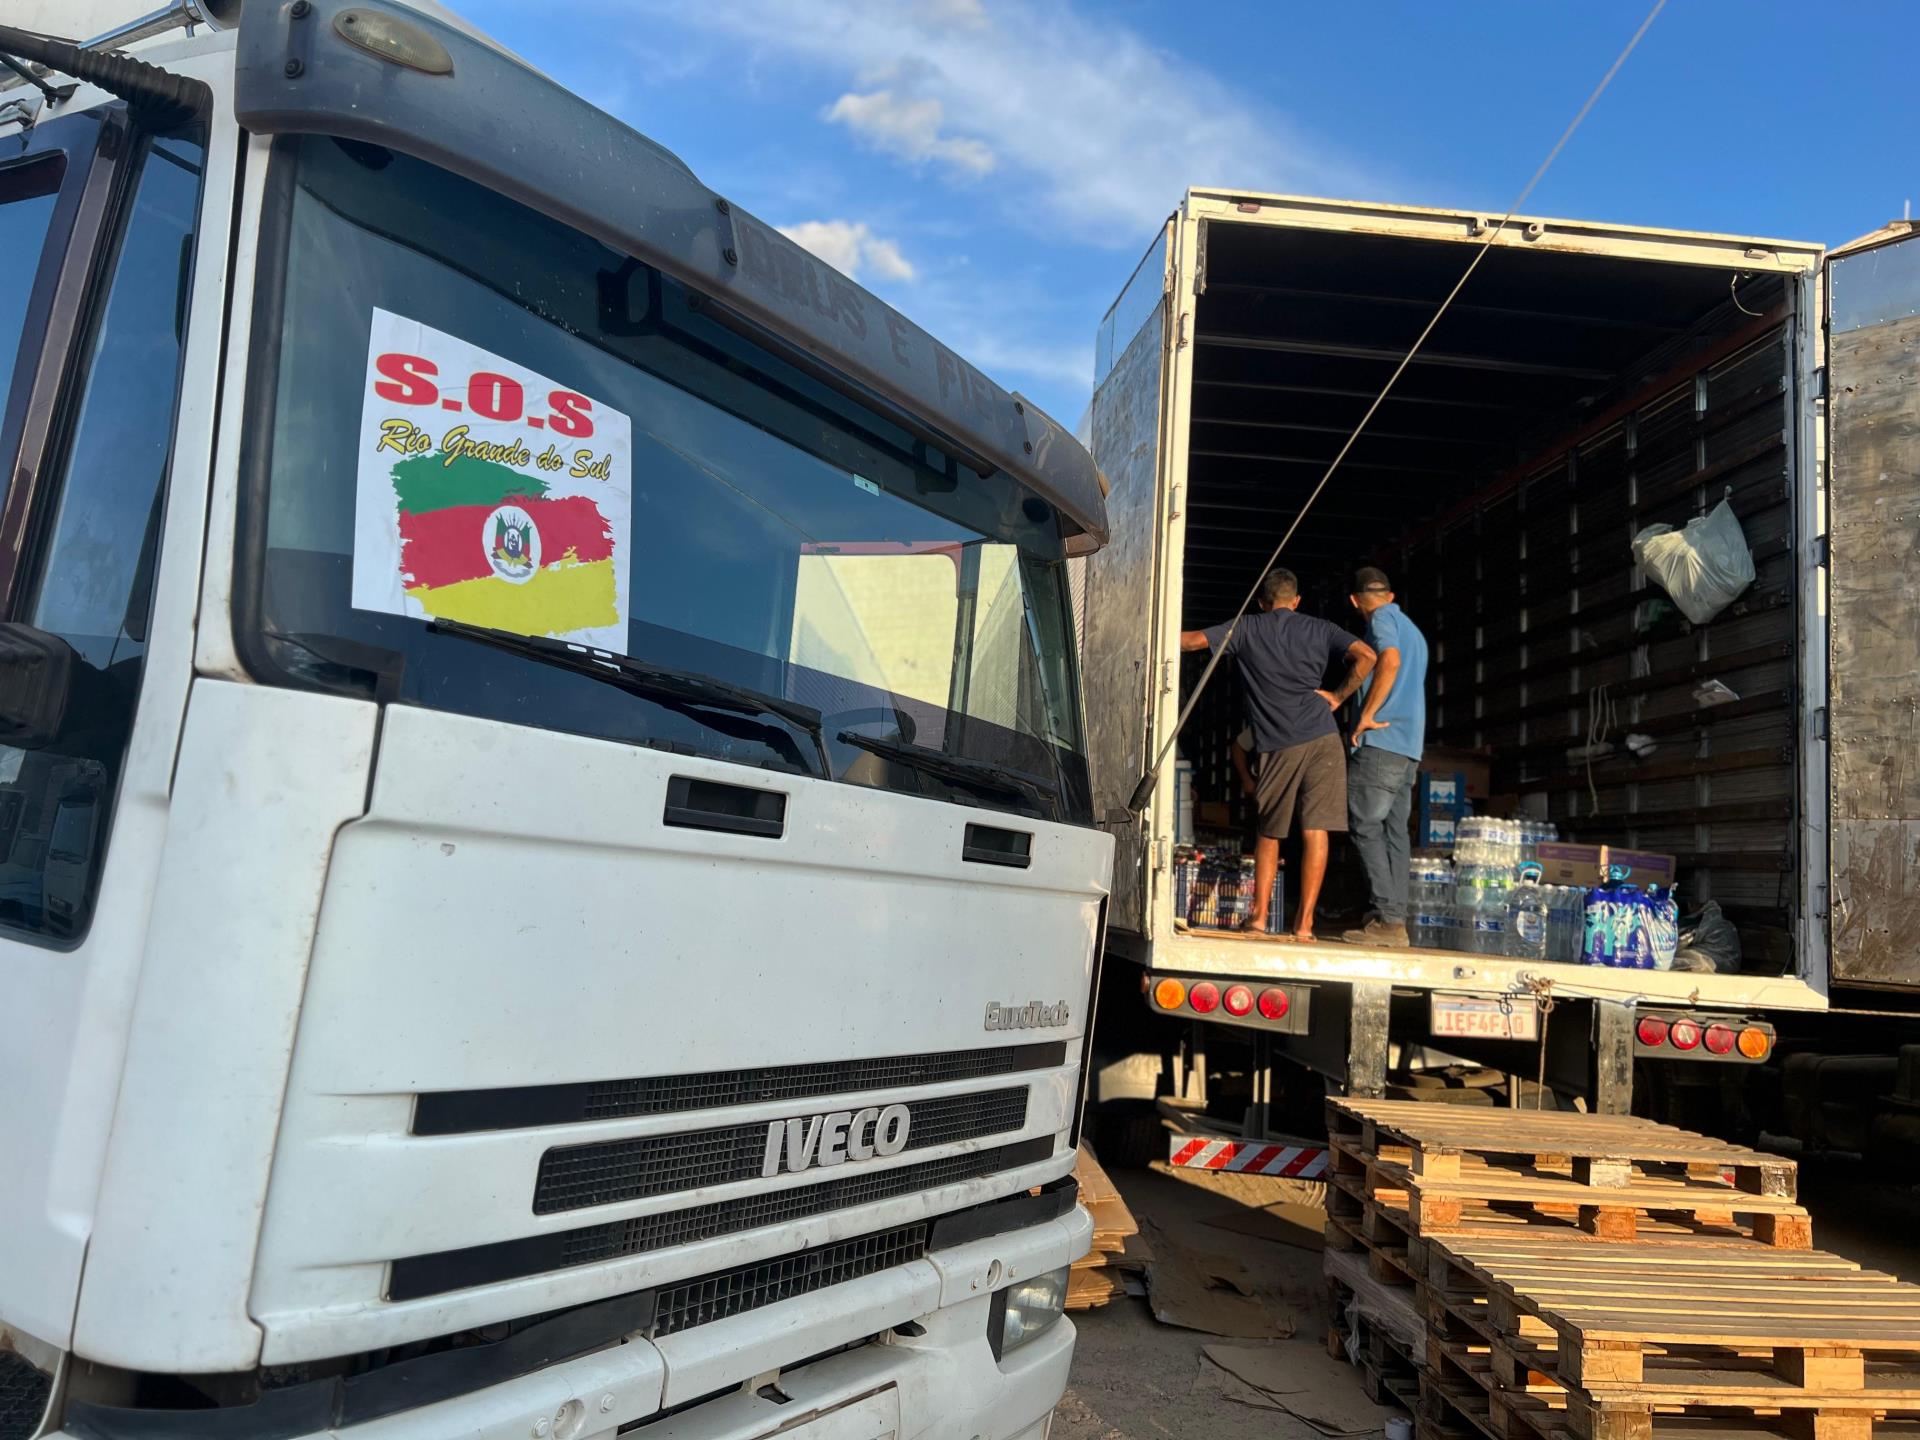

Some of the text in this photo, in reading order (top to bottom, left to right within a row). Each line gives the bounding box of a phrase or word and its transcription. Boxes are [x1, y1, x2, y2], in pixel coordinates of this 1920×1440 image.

[374, 353, 594, 438] S.O.S
[377, 419, 612, 480] Rio Grande do Sul
[985, 1000, 1069, 1031] EuroTech
[761, 1104, 911, 1178] IVECO
